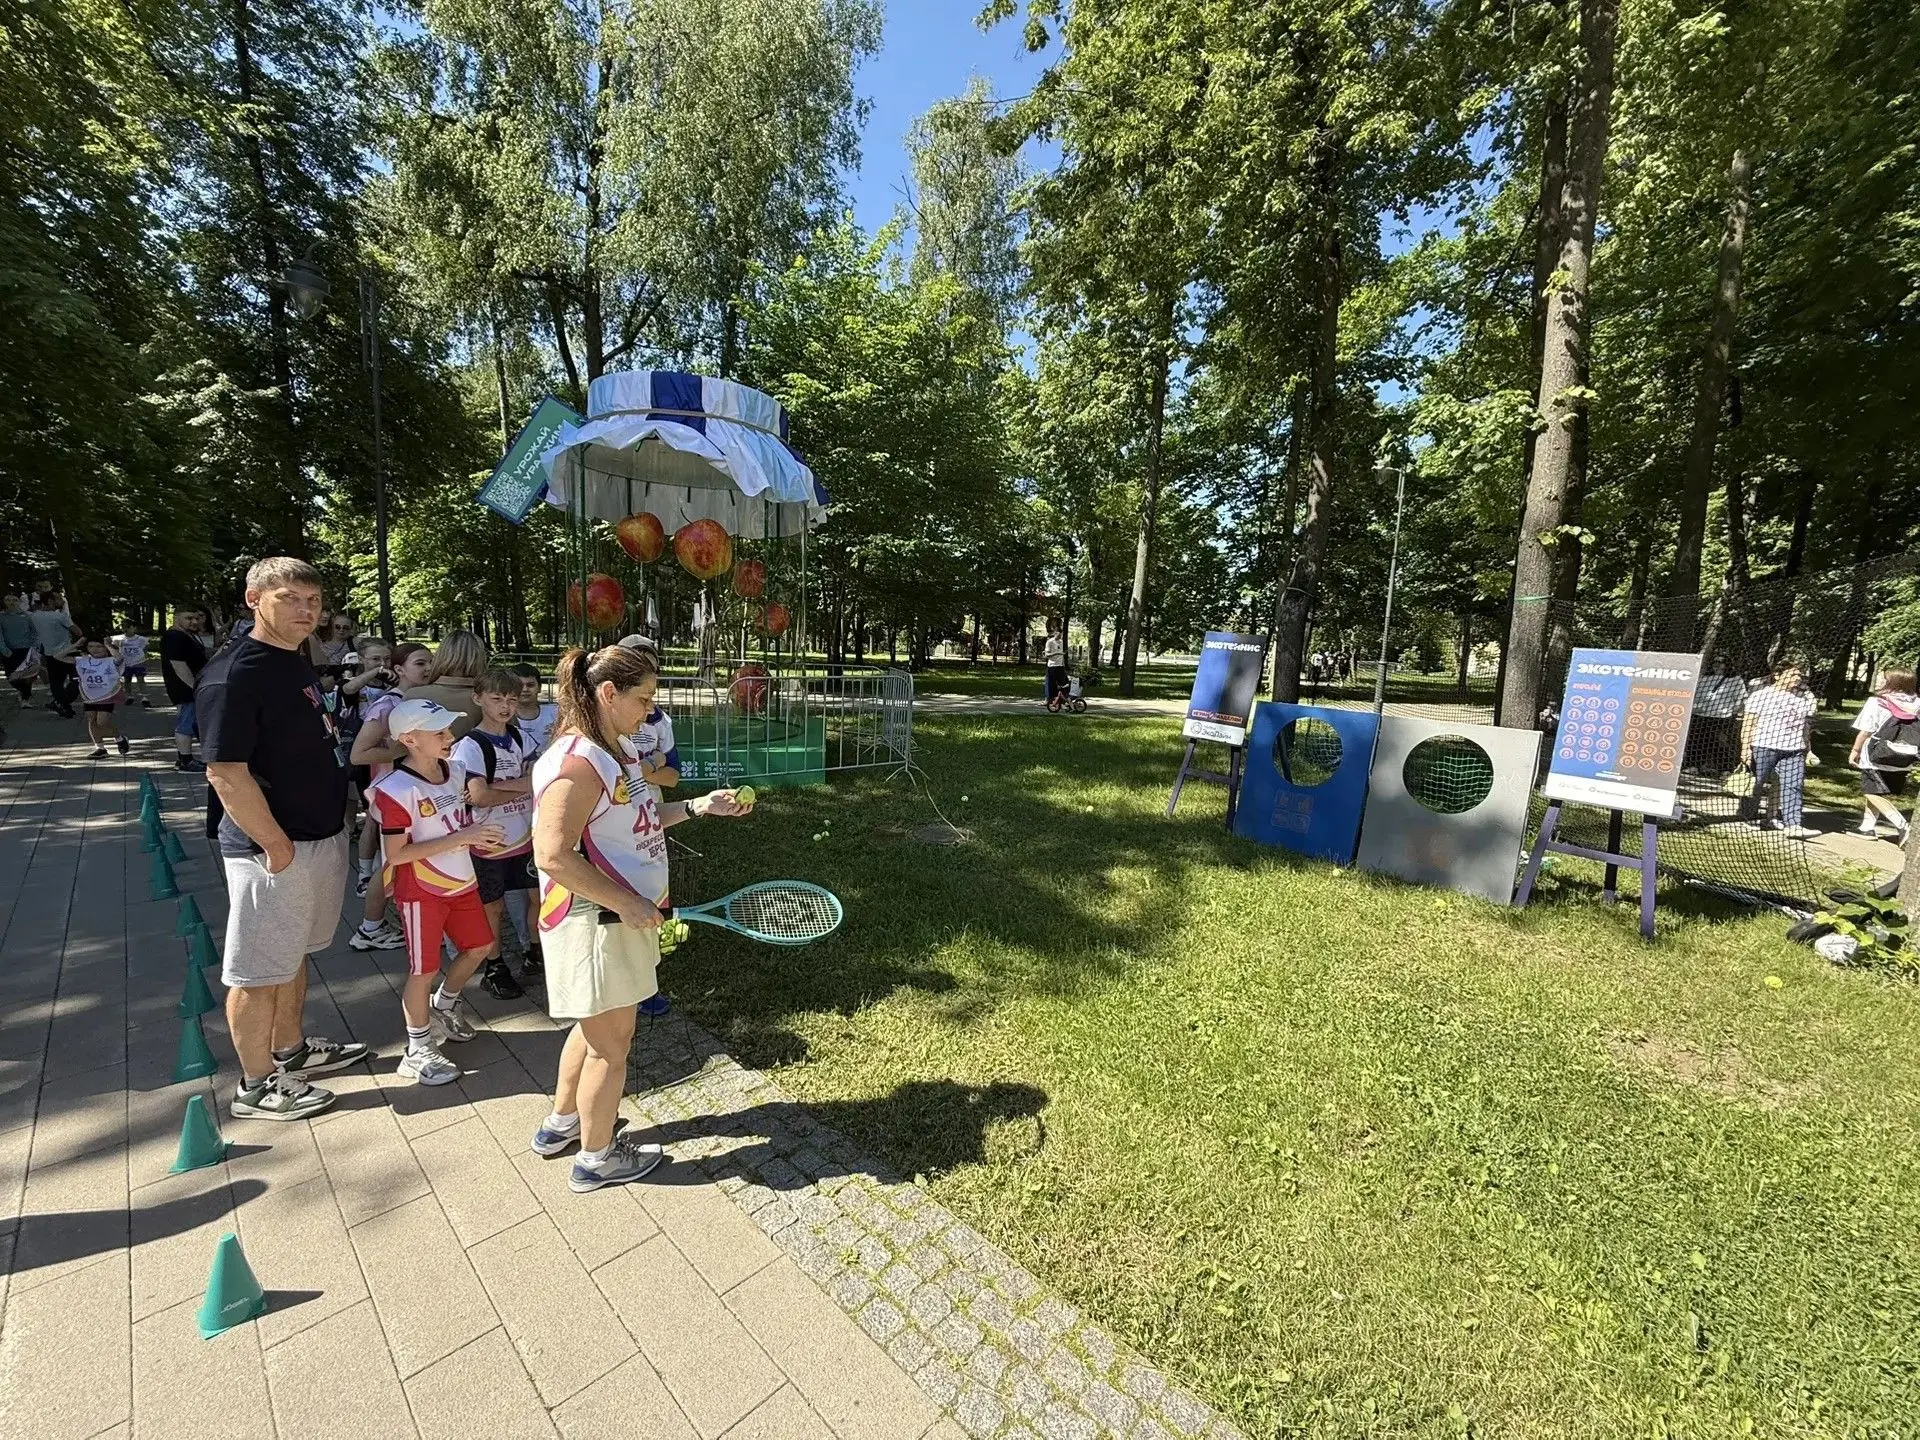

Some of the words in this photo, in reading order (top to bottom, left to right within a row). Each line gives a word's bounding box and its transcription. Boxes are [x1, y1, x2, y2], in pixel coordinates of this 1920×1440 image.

[513, 426, 551, 475] УРОЖАЙ
[523, 424, 563, 481] УРАХИМ
[87, 675, 104, 684] 48
[633, 798, 662, 836] 43
